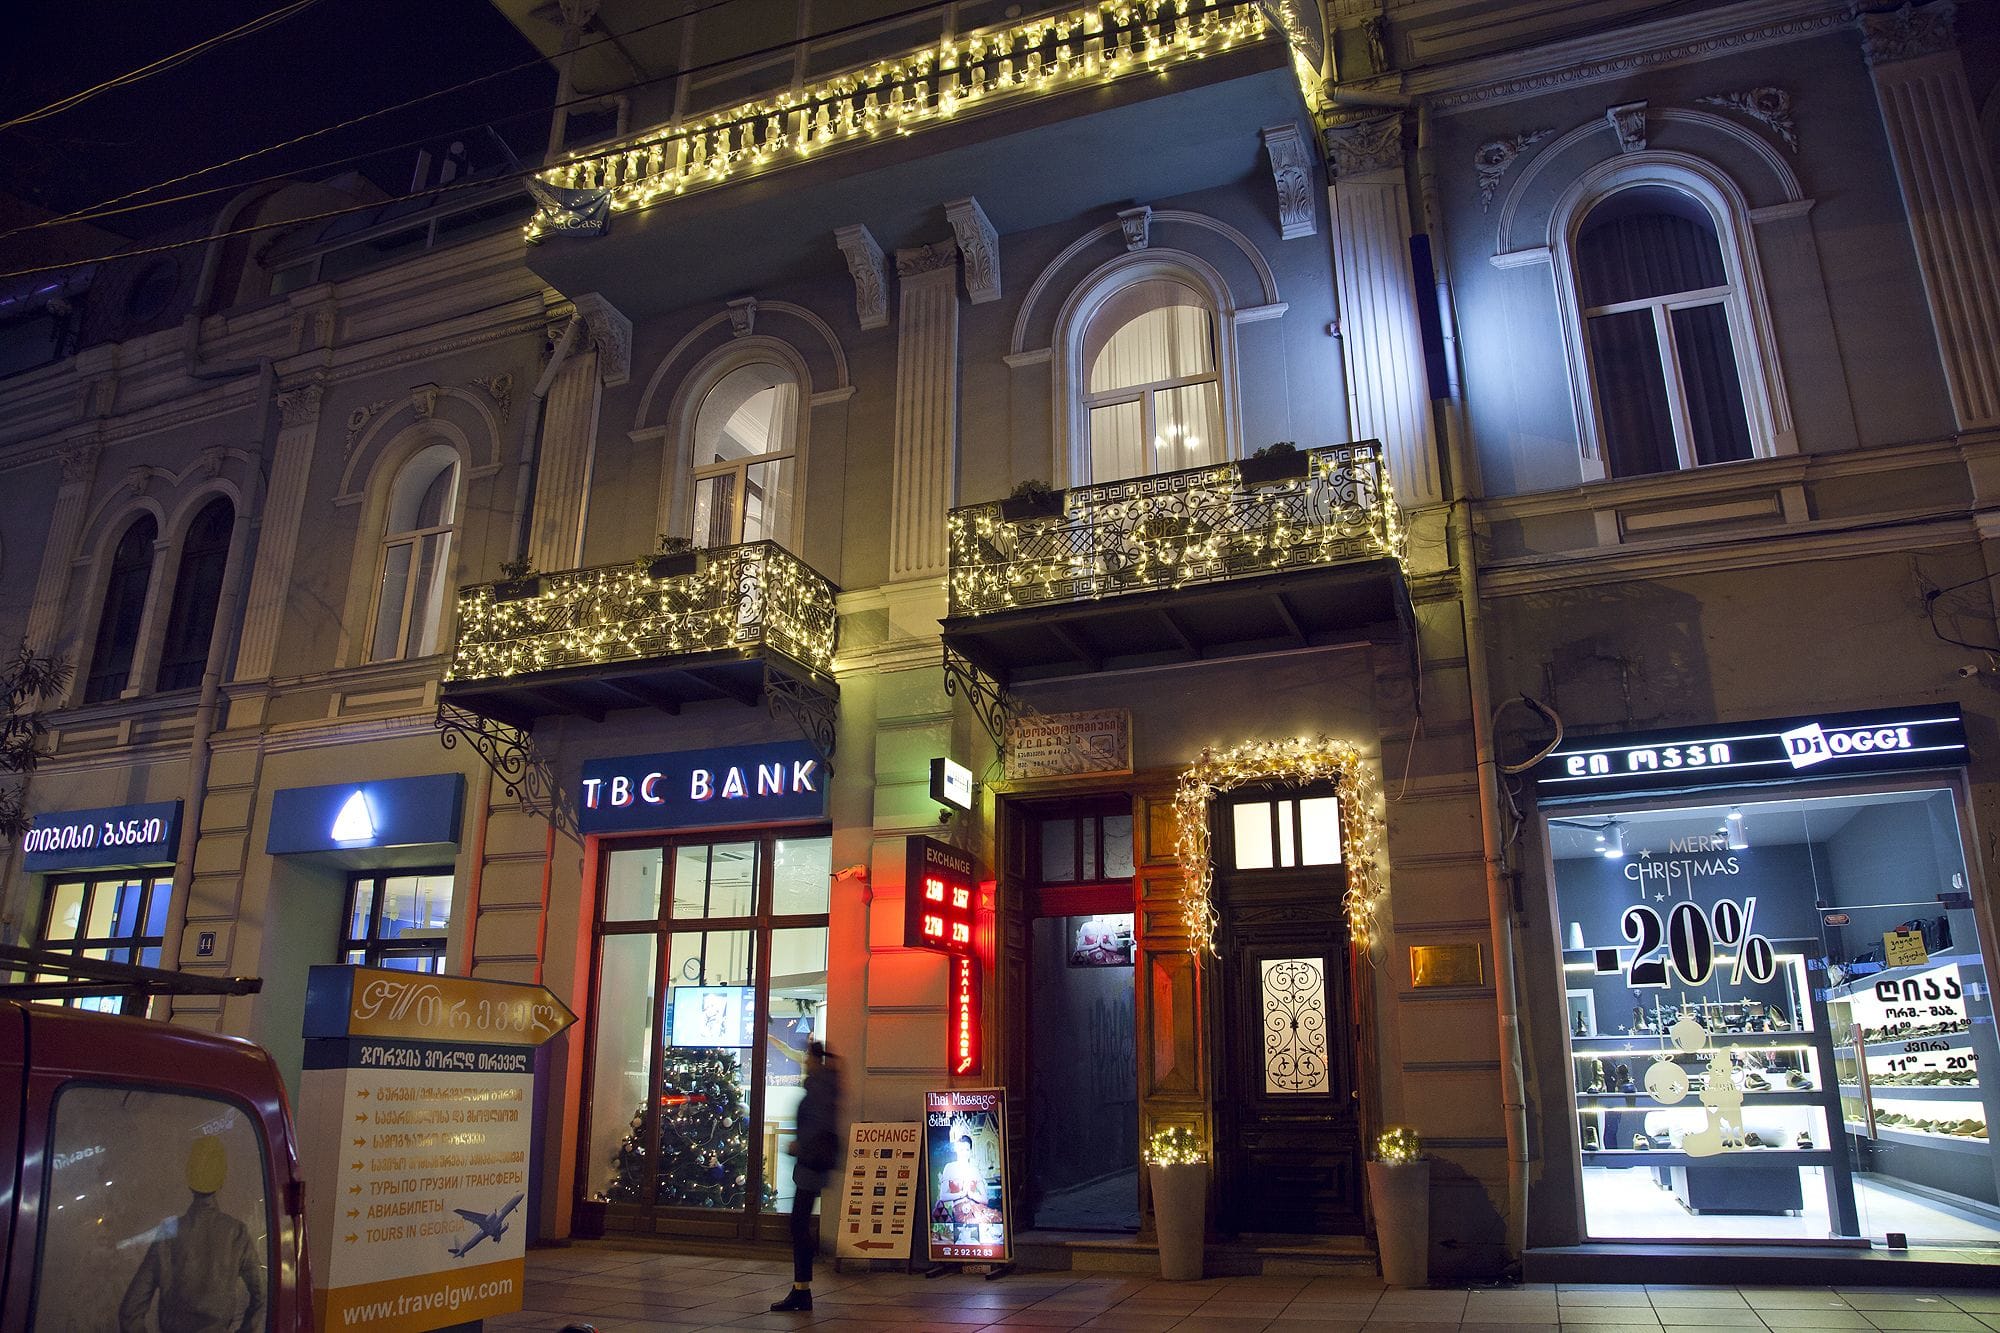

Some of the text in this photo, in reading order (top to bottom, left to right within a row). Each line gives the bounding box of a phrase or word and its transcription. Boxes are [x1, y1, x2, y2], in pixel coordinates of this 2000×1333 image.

[583, 760, 816, 809] TBC BANK
[23, 817, 161, 853] თიბისი ბანკი
[1669, 835, 1731, 854] MERRY
[926, 847, 971, 875] EXCHANGE
[1624, 857, 1740, 899] CHRISTMAS
[1875, 977, 1961, 1002] ღიაა
[360, 1046, 527, 1071] ჯორჯია ვორლდ თრეველ
[1904, 1041, 1951, 1053] კვირა
[928, 1092, 996, 1110] Thai Massage
[452, 1110, 465, 1124] და
[856, 1129, 917, 1143] EXCHANGE
[370, 1181, 400, 1196] ТУРЫ
[401, 1179, 417, 1193] ПО
[420, 1175, 459, 1192] ГРУЗИИ
[466, 1170, 523, 1187] ТРАНСФЕРЫ
[367, 1199, 444, 1219] АВИАБИЛЕТЫ
[366, 1220, 465, 1243] TOURS IN GEORGIA
[343, 1277, 513, 1326] www.travelgw.com
